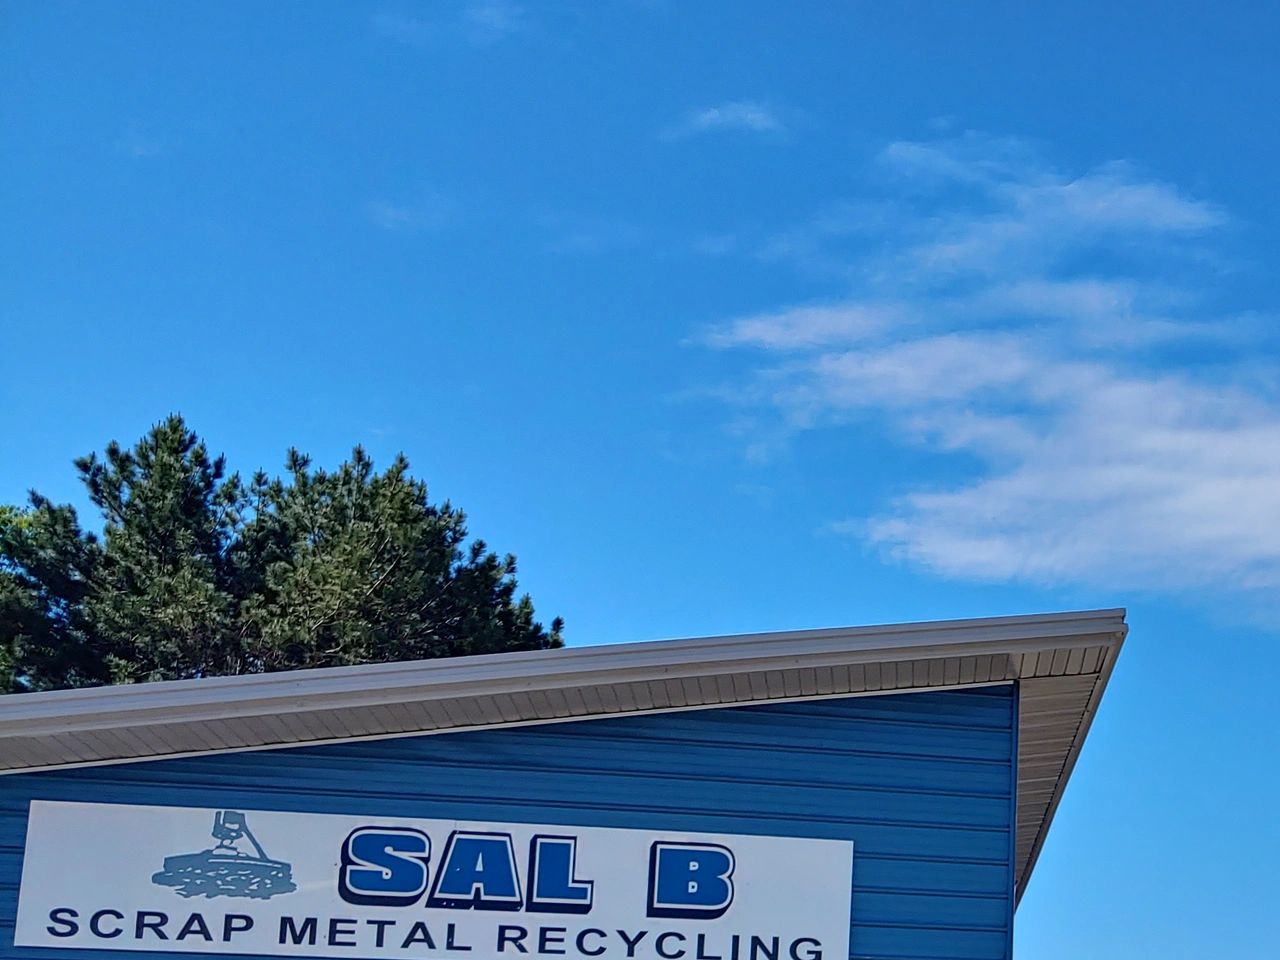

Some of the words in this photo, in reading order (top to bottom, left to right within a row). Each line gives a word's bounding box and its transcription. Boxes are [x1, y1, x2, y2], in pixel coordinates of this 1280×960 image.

[338, 825, 595, 915] SAL
[646, 840, 736, 920] B
[46, 907, 255, 942] SCRAP
[278, 916, 473, 951] METAL
